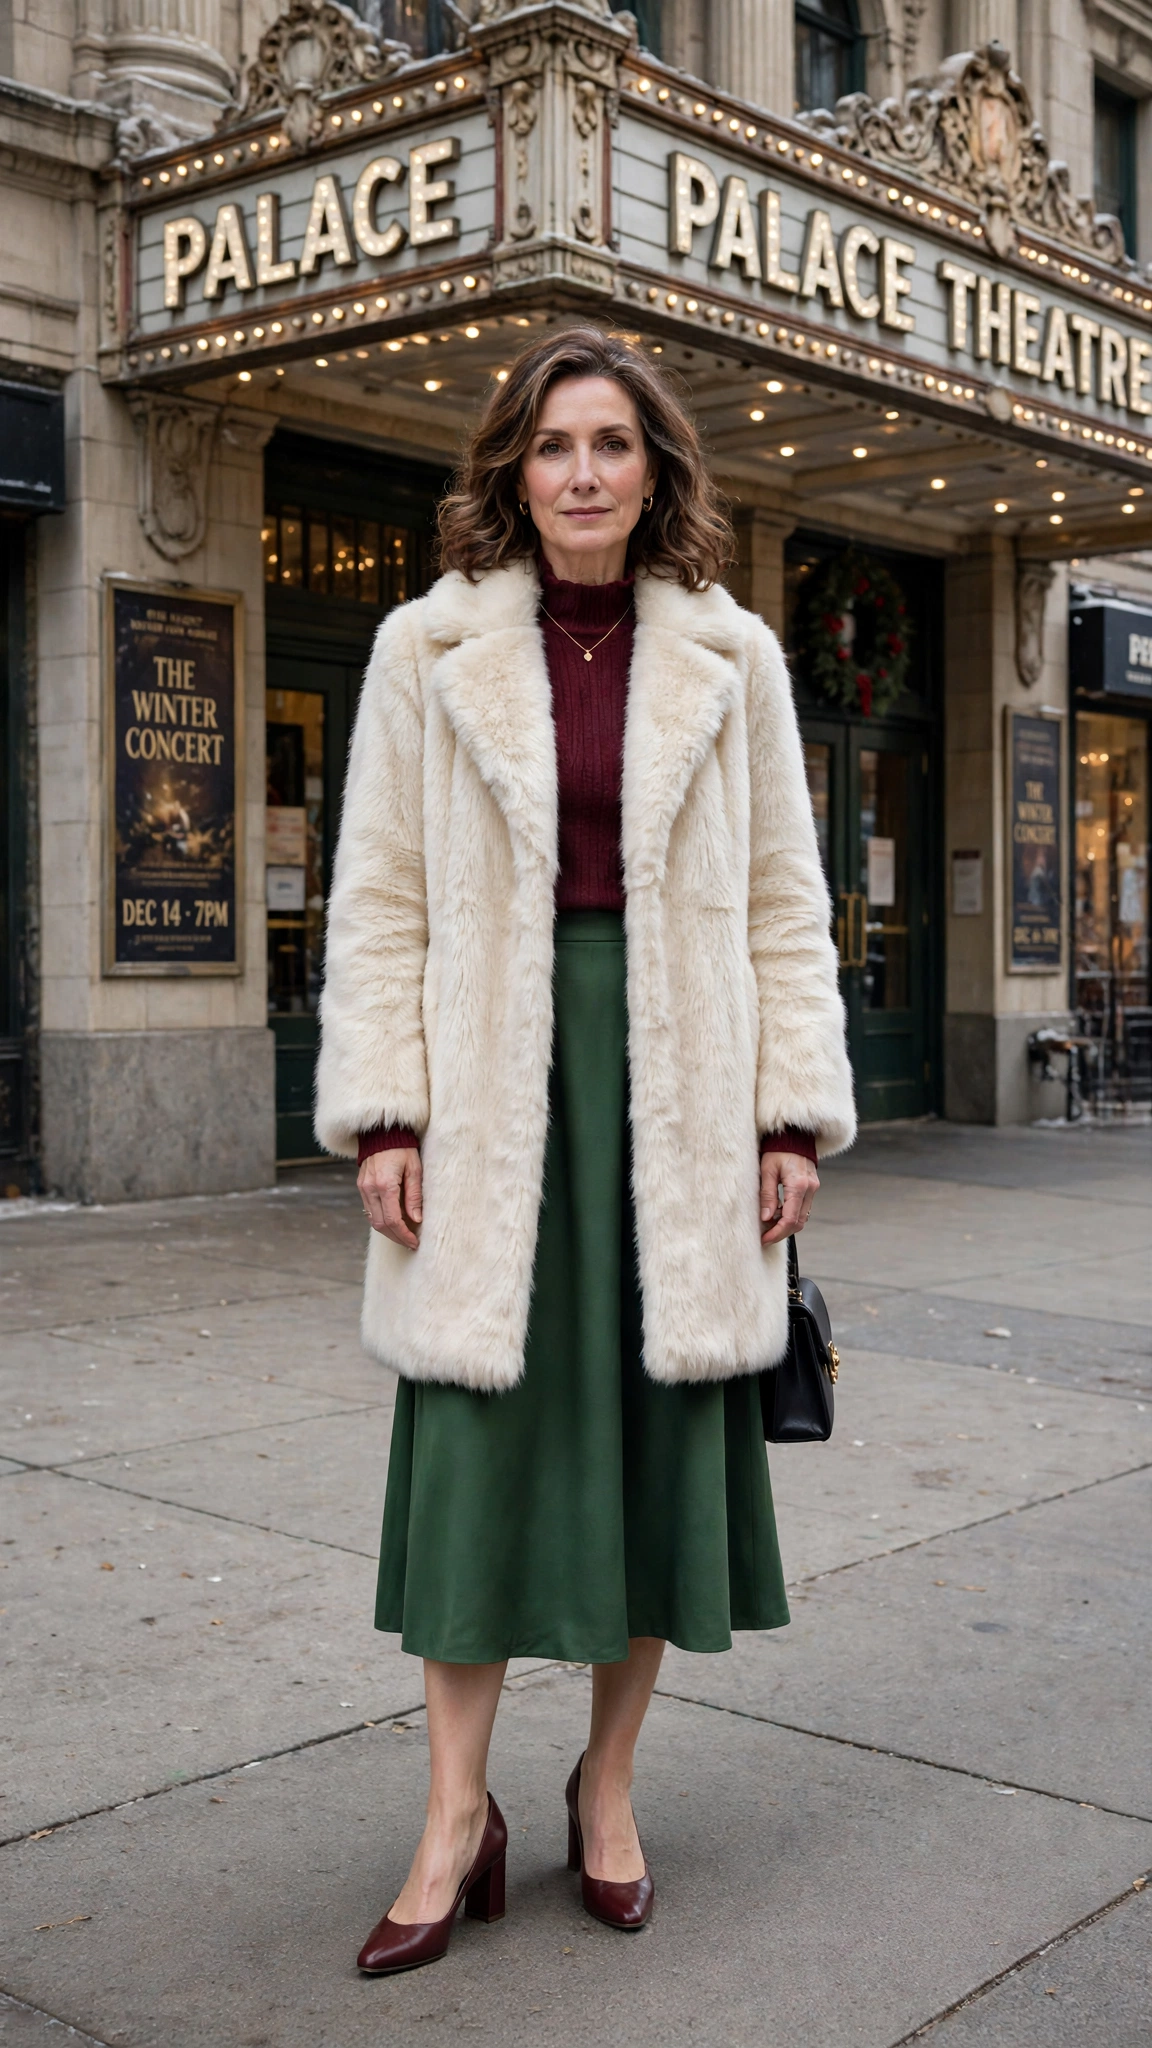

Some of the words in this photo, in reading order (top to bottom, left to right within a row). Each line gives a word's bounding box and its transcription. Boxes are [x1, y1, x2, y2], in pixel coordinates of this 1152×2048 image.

[163, 136, 461, 310] PALACE
[667, 151, 917, 334] PALACE
[937, 260, 1152, 416] THEATRE
[153, 656, 196, 690] THE
[132, 690, 218, 729] WINTER
[125, 727, 225, 766] CONCERT
[122, 898, 158, 927] DEC
[161, 899, 182, 927] 14
[194, 900, 228, 928] 7PM
